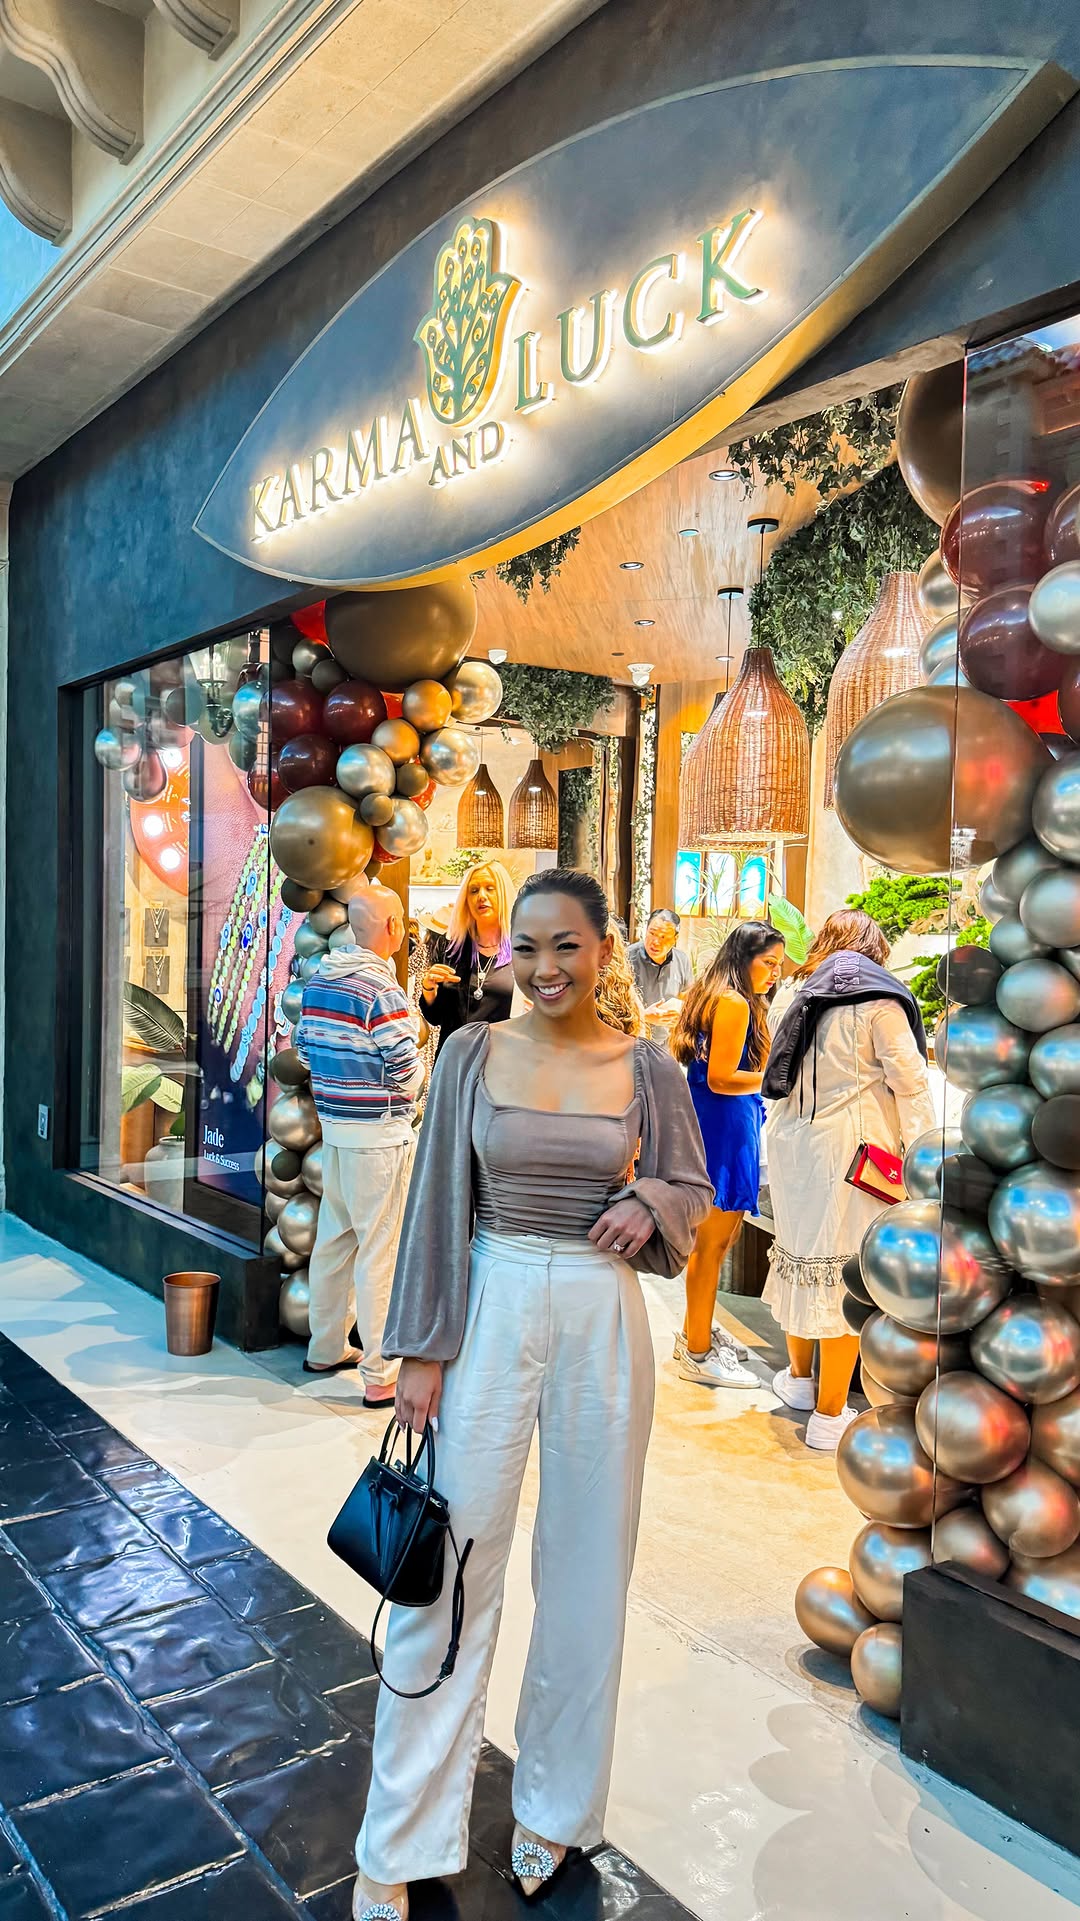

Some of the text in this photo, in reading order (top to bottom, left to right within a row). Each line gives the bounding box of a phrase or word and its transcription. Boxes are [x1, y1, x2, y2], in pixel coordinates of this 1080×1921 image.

[250, 208, 767, 542] KARMA AND LUCK
[203, 1125, 225, 1148] Jade
[203, 1149, 216, 1162] Luck
[220, 1155, 240, 1171] Success
